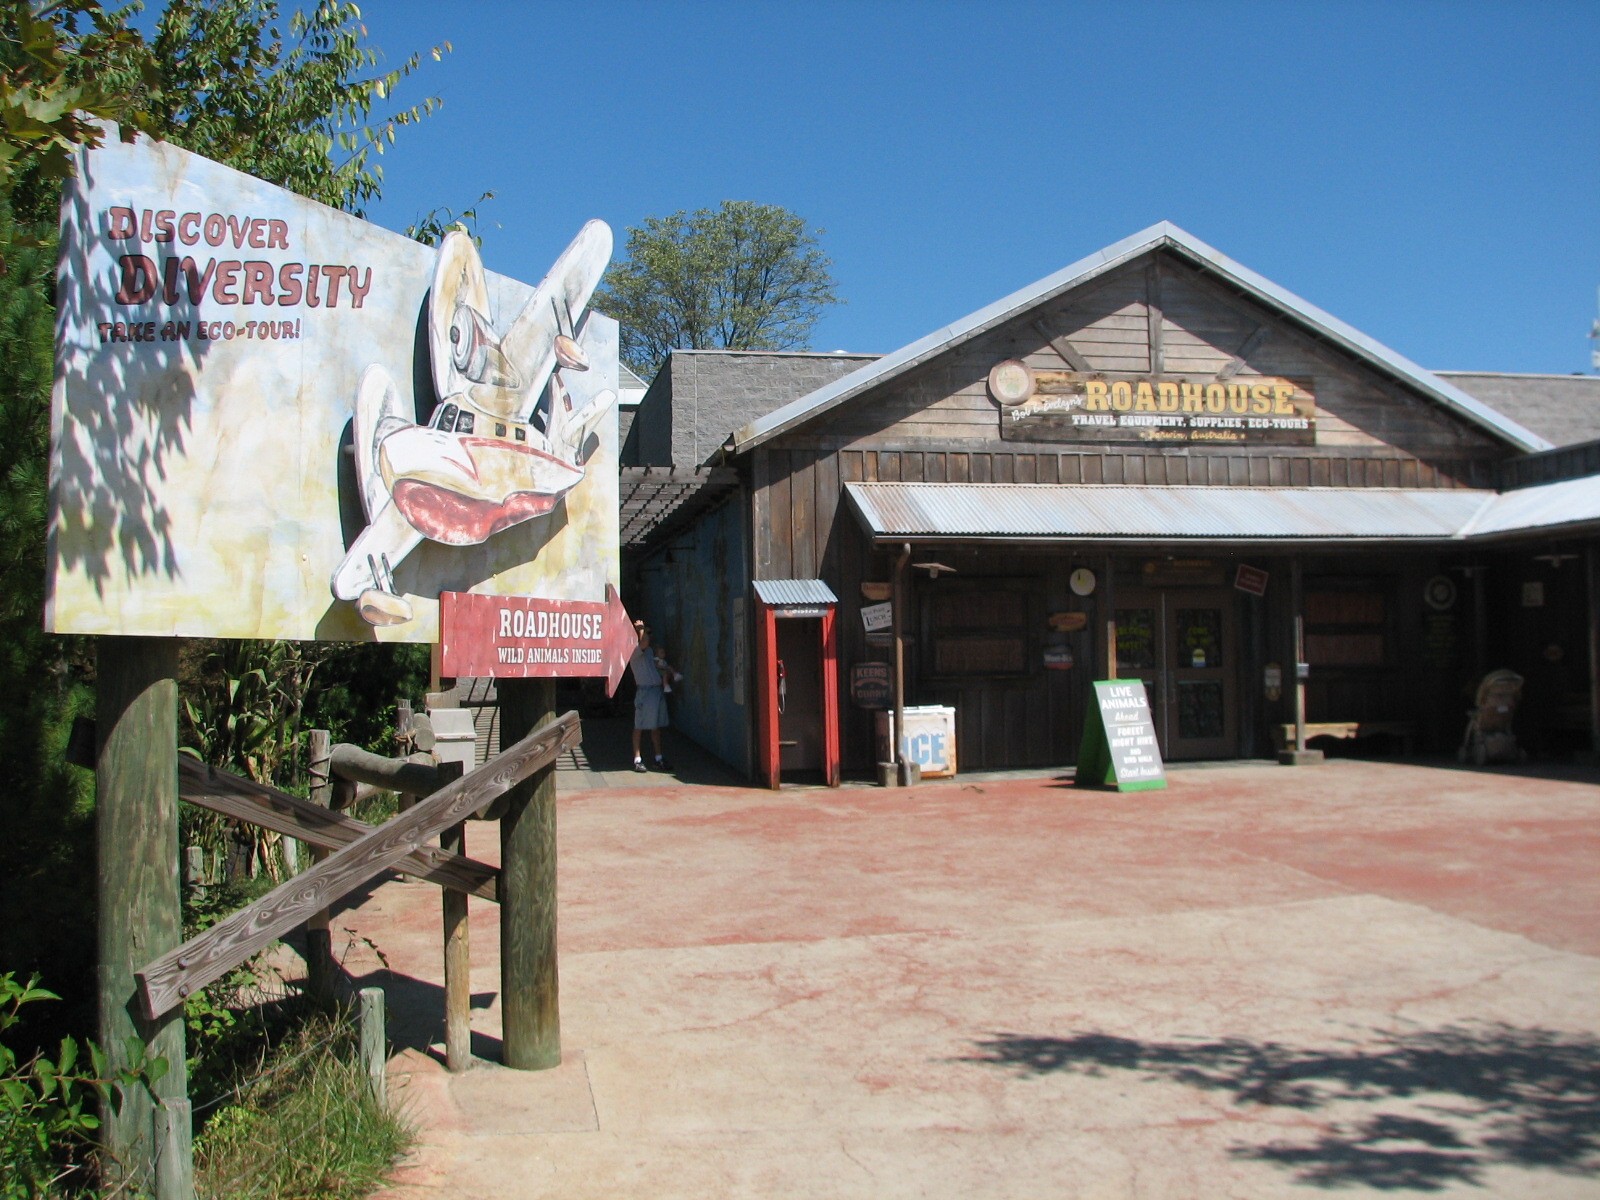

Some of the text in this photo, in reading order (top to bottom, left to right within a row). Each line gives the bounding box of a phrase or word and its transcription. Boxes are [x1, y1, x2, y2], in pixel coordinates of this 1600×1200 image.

[108, 206, 289, 249] DISCOVER
[115, 254, 372, 308] DIVERSITY
[98, 318, 301, 343] TAKE AN ECO-TOUR!
[1085, 381, 1295, 415] ROADHOUSE
[1011, 406, 1031, 421] Bob
[1072, 415, 1309, 429] TRAVEL EQUIPMENT, SUPPLIES, ECO-TOURS
[1191, 430, 1238, 440] Australia
[499, 608, 602, 640] ROADHOUSE
[498, 648, 602, 664] WILD ANIMALS INSIDE
[1110, 687, 1132, 697] LIVE
[1102, 697, 1146, 709] ANIMALS
[1118, 727, 1144, 736] FOREST
[903, 733, 945, 765] ICE
